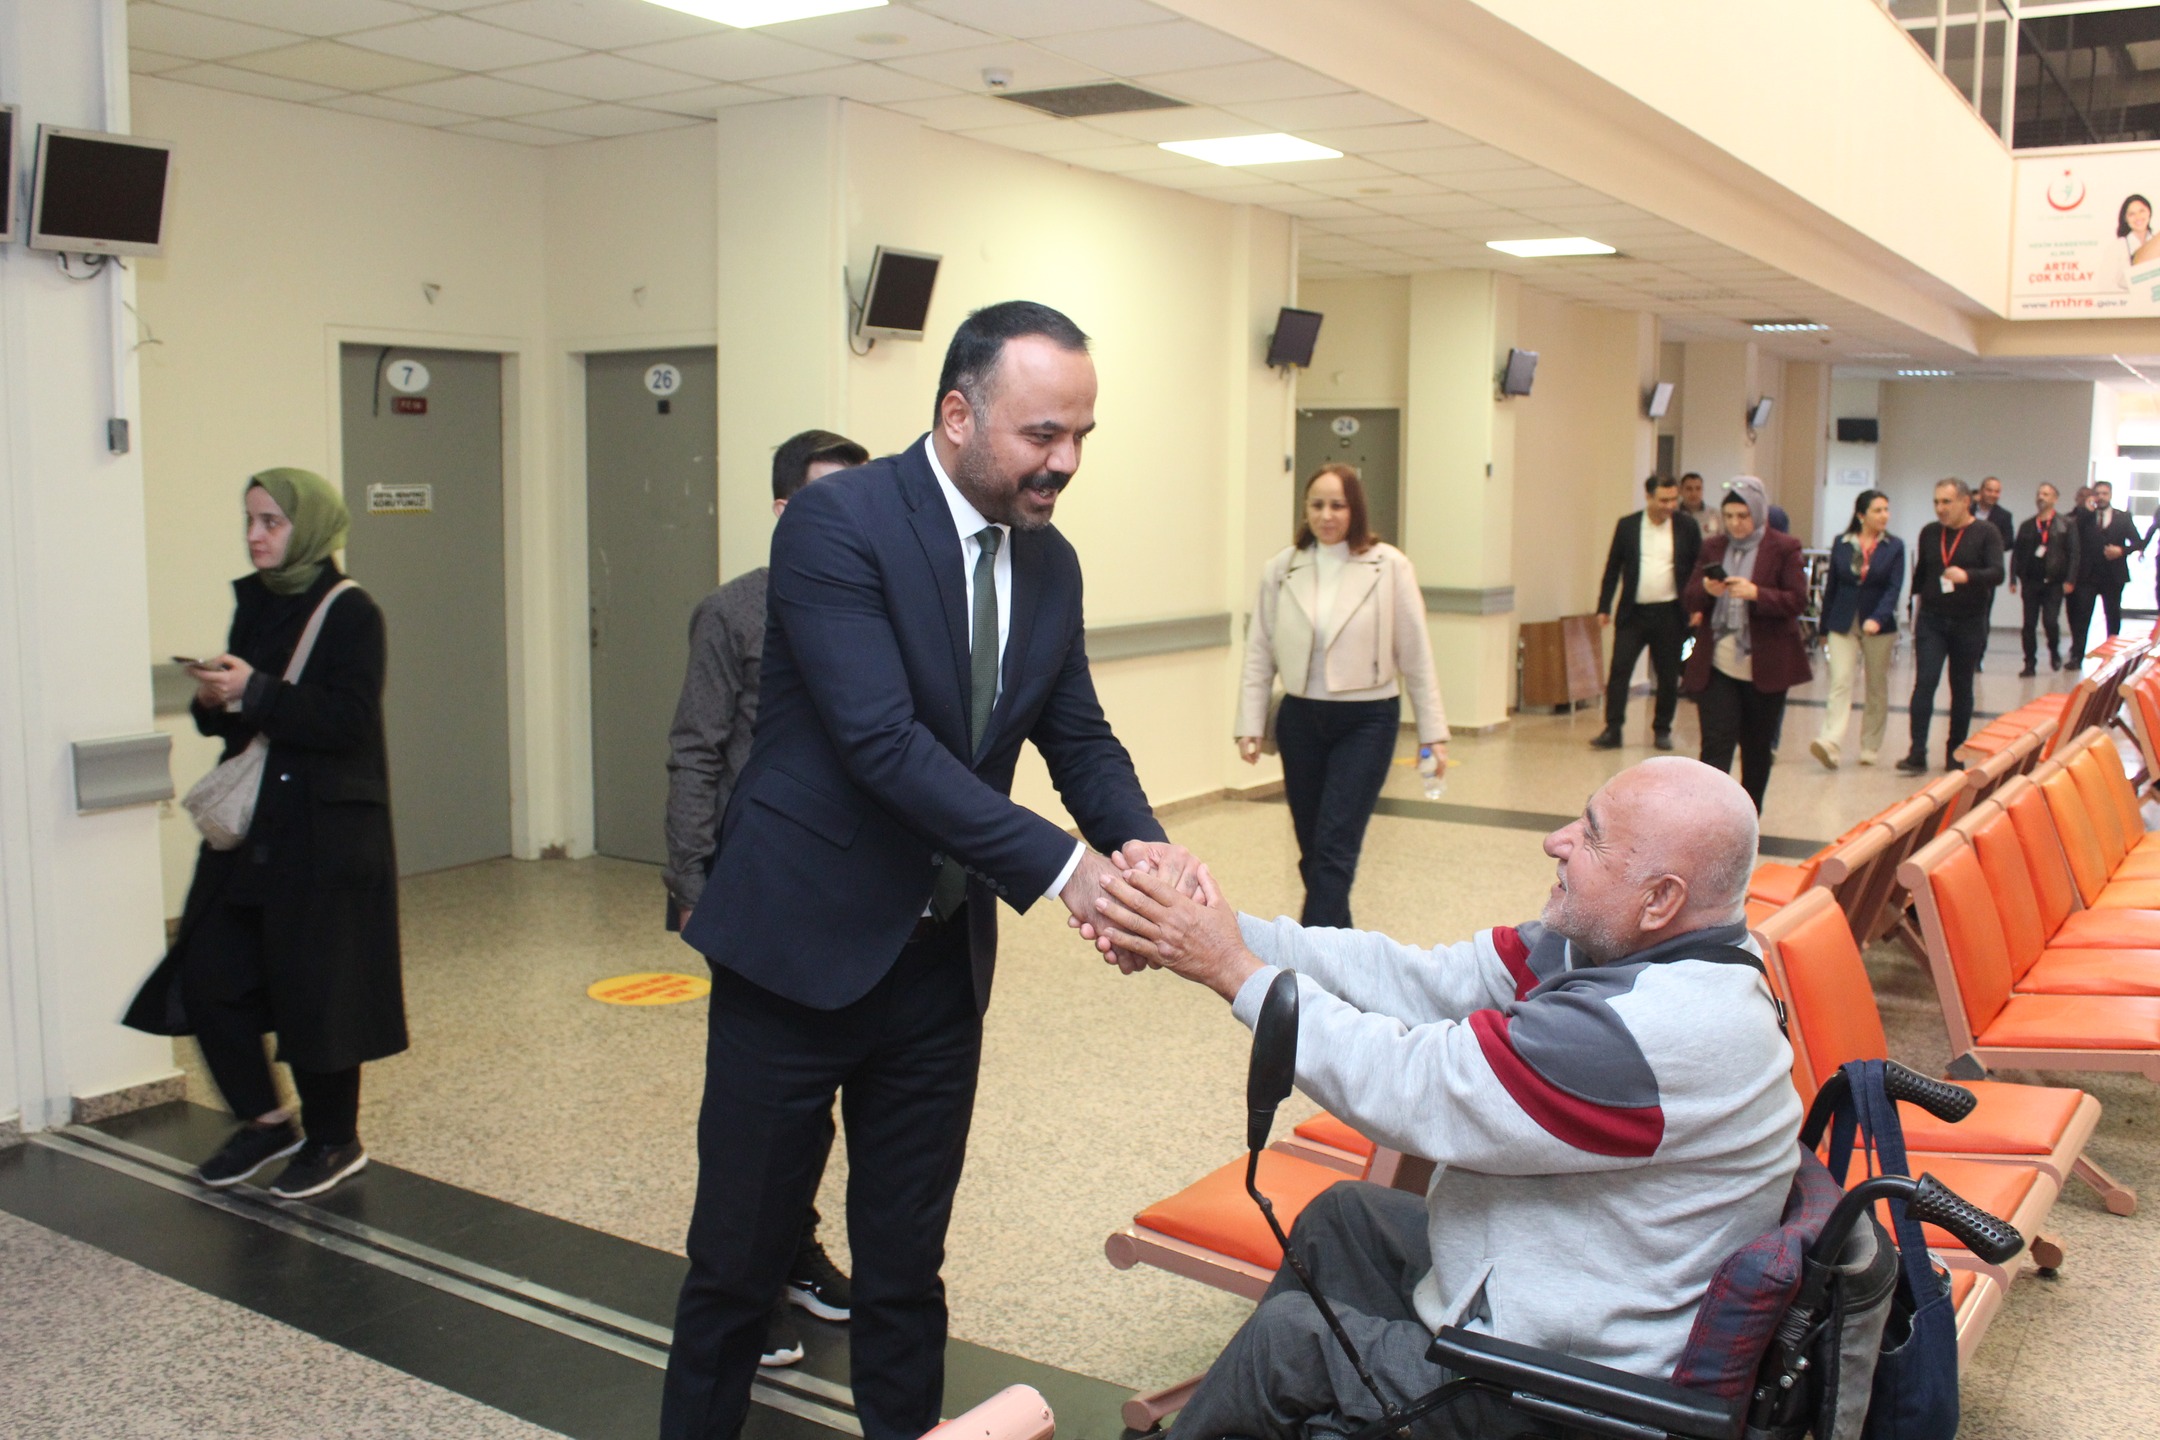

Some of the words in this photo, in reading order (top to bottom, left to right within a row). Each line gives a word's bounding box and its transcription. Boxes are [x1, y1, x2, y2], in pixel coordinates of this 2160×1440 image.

[2044, 261, 2079, 272] ARTIK
[2055, 271, 2094, 282] KOLAY
[402, 366, 413, 385] 7
[653, 369, 672, 389] 26
[1338, 420, 1353, 432] 24
